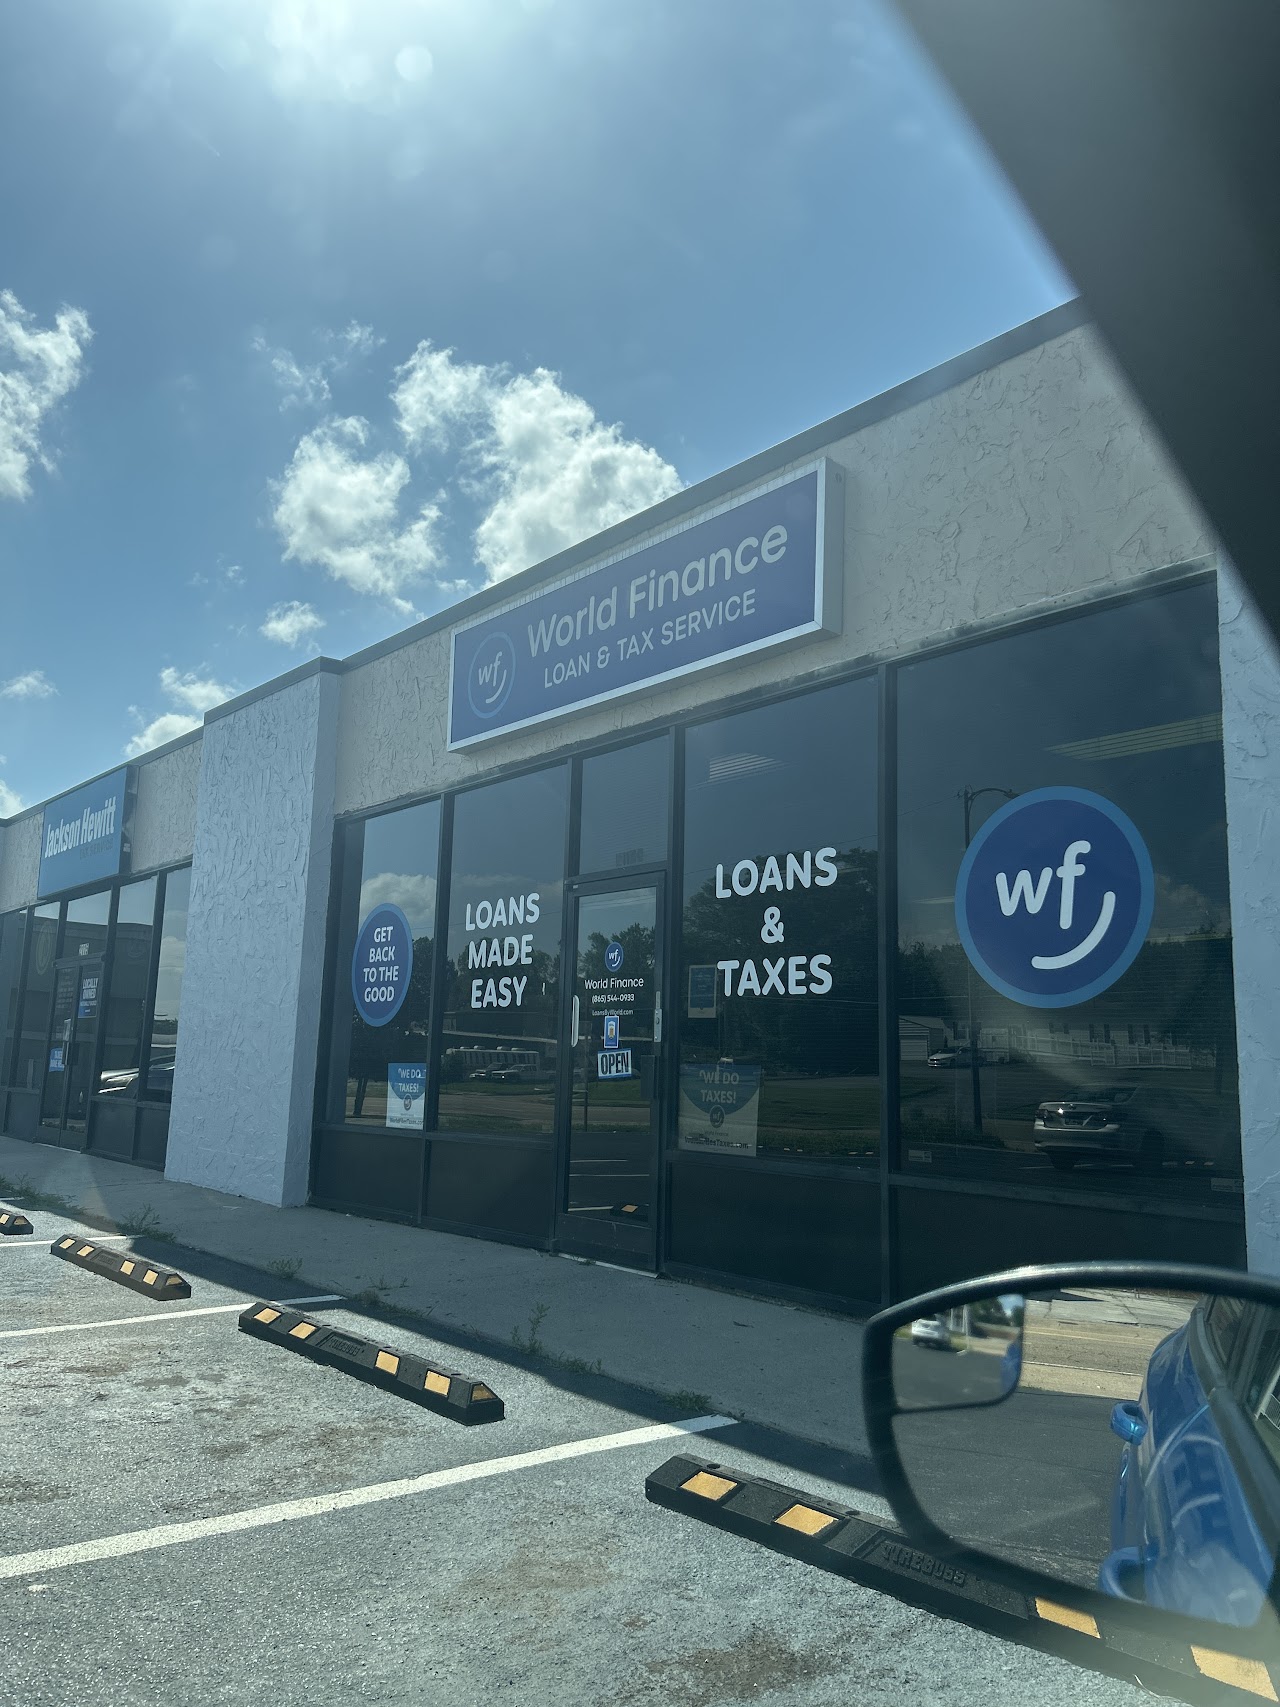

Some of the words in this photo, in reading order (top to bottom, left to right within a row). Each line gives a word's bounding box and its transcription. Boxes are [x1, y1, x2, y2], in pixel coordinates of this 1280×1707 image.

[527, 585, 618, 658] World
[628, 523, 789, 620] Finance
[543, 650, 591, 689] LOAN
[597, 646, 611, 669] &
[617, 628, 655, 662] TAX
[660, 588, 757, 647] SERVICE
[44, 817, 81, 859] Jackson
[81, 796, 117, 845] Hewitt
[715, 847, 838, 899] LOANS
[465, 892, 540, 932] LOANS
[373, 925, 394, 943] GET
[760, 906, 785, 944] &
[369, 946, 396, 963] BACK
[467, 933, 534, 970] MADE
[363, 968, 378, 983] TO
[378, 966, 400, 982] THE
[585, 978, 608, 990] World
[609, 977, 645, 989] Finance
[716, 953, 833, 997] TAXES
[364, 986, 395, 1003] GOOD
[471, 975, 528, 1009] EASY
[591, 994, 607, 1004] (865)
[606, 993, 635, 1003] 544-0933
[410, 1069, 422, 1079] DO
[600, 1052, 630, 1076] OPEN
[398, 1083, 420, 1093] TAXES!
[721, 1072, 740, 1085] DO
[700, 1089, 737, 1104] TAXES!
